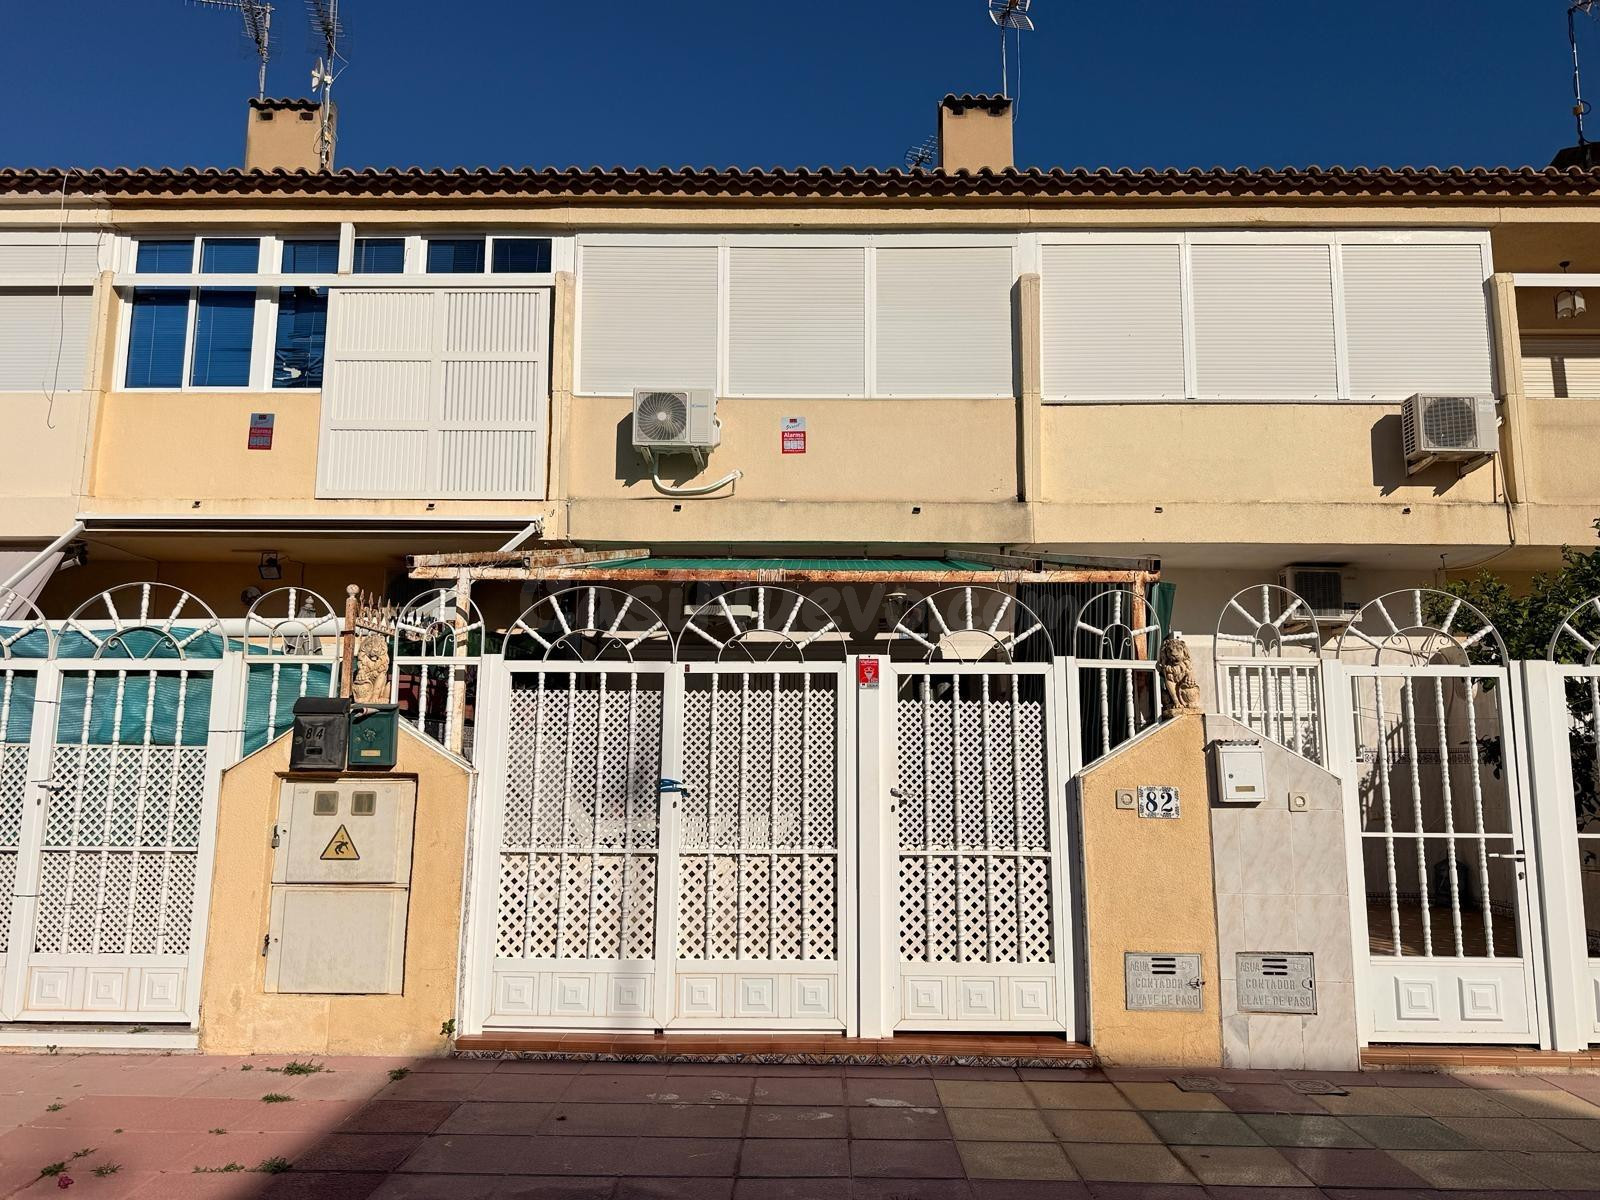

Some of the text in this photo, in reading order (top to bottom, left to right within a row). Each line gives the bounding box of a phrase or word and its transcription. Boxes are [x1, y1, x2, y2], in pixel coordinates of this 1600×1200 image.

[305, 728, 324, 740] 84
[1146, 791, 1173, 812] 82
[1130, 961, 1150, 972] AGUA
[1240, 961, 1262, 972] AGUA
[1135, 978, 1183, 989] CONTADOR
[1245, 978, 1296, 990] CONTADOR
[1161, 994, 1173, 1005] DE
[1175, 995, 1198, 1006] PASO
[1241, 994, 1311, 1007] LLAVE DE PASO
